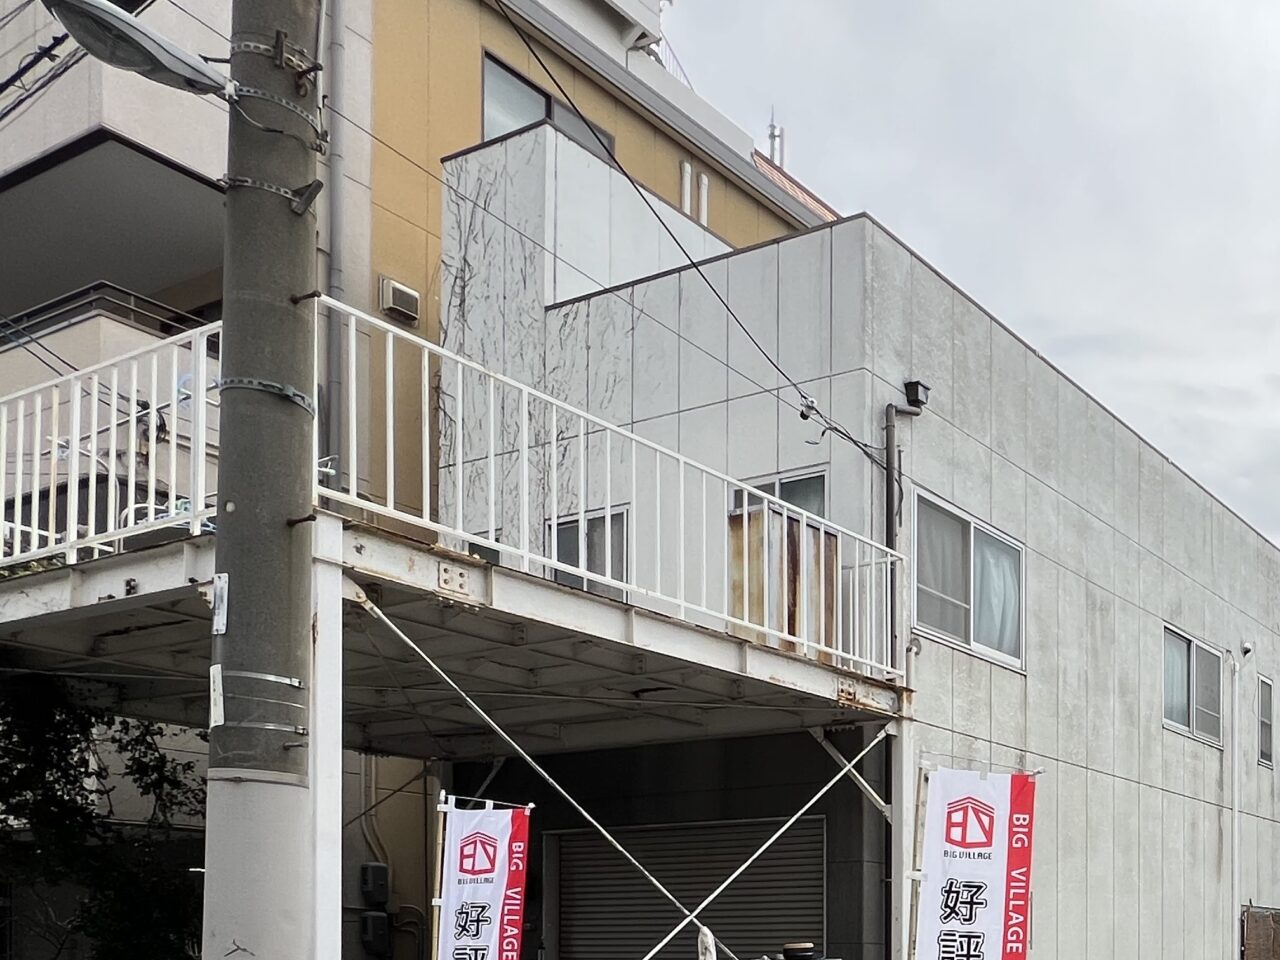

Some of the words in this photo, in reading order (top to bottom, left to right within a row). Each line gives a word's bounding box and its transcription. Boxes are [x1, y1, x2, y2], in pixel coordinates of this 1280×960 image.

[510, 842, 524, 871] BIG
[1012, 814, 1029, 848] BIG
[503, 887, 522, 960] VILLAGE
[1006, 867, 1027, 953] VILLAGE
